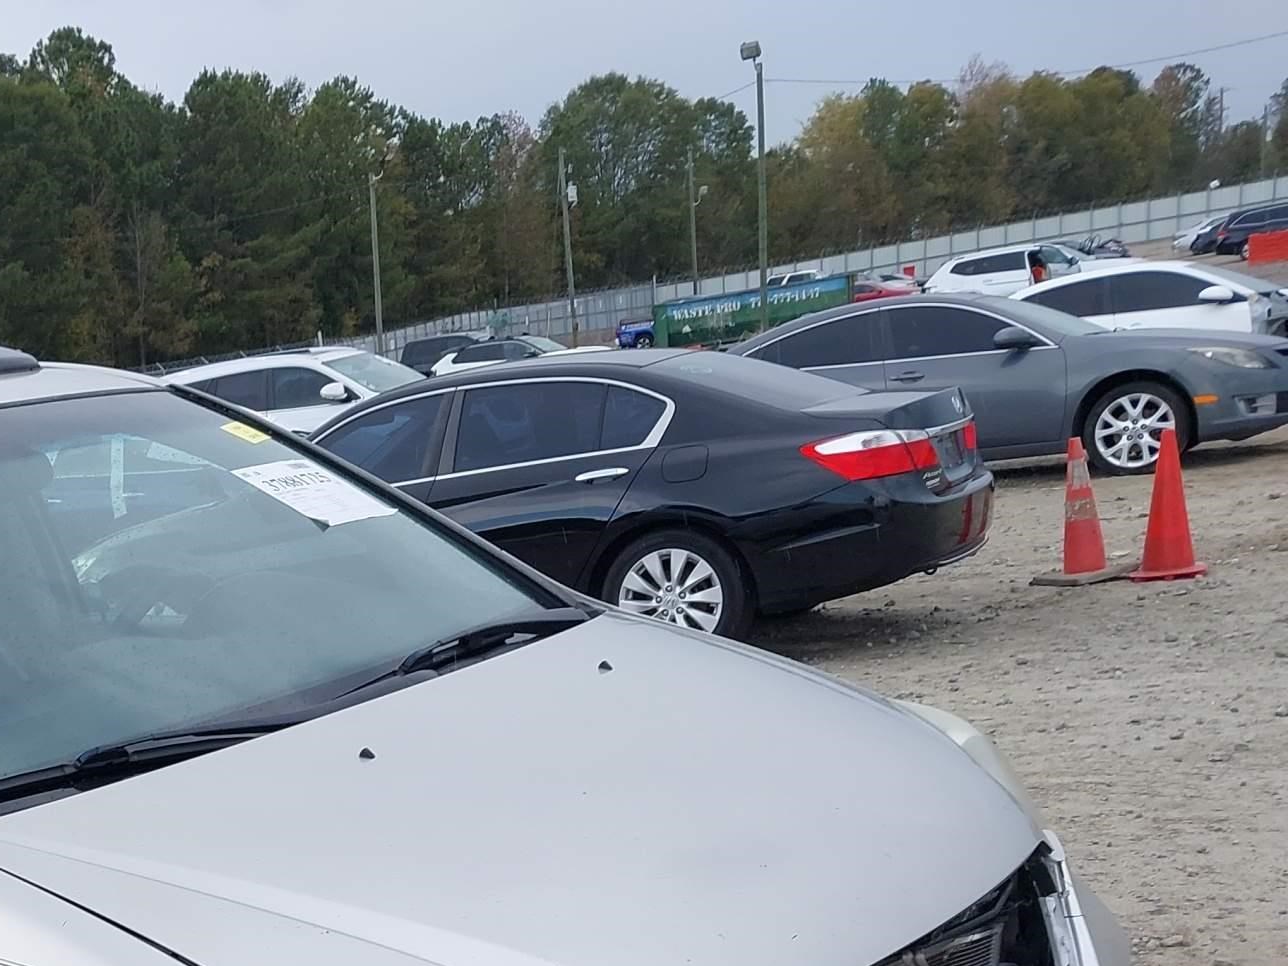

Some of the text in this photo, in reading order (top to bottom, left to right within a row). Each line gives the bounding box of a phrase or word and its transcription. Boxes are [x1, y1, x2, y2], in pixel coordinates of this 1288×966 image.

[673, 303, 713, 321] WASTE
[716, 300, 741, 314] PRO
[261, 471, 332, 492] 37881725
